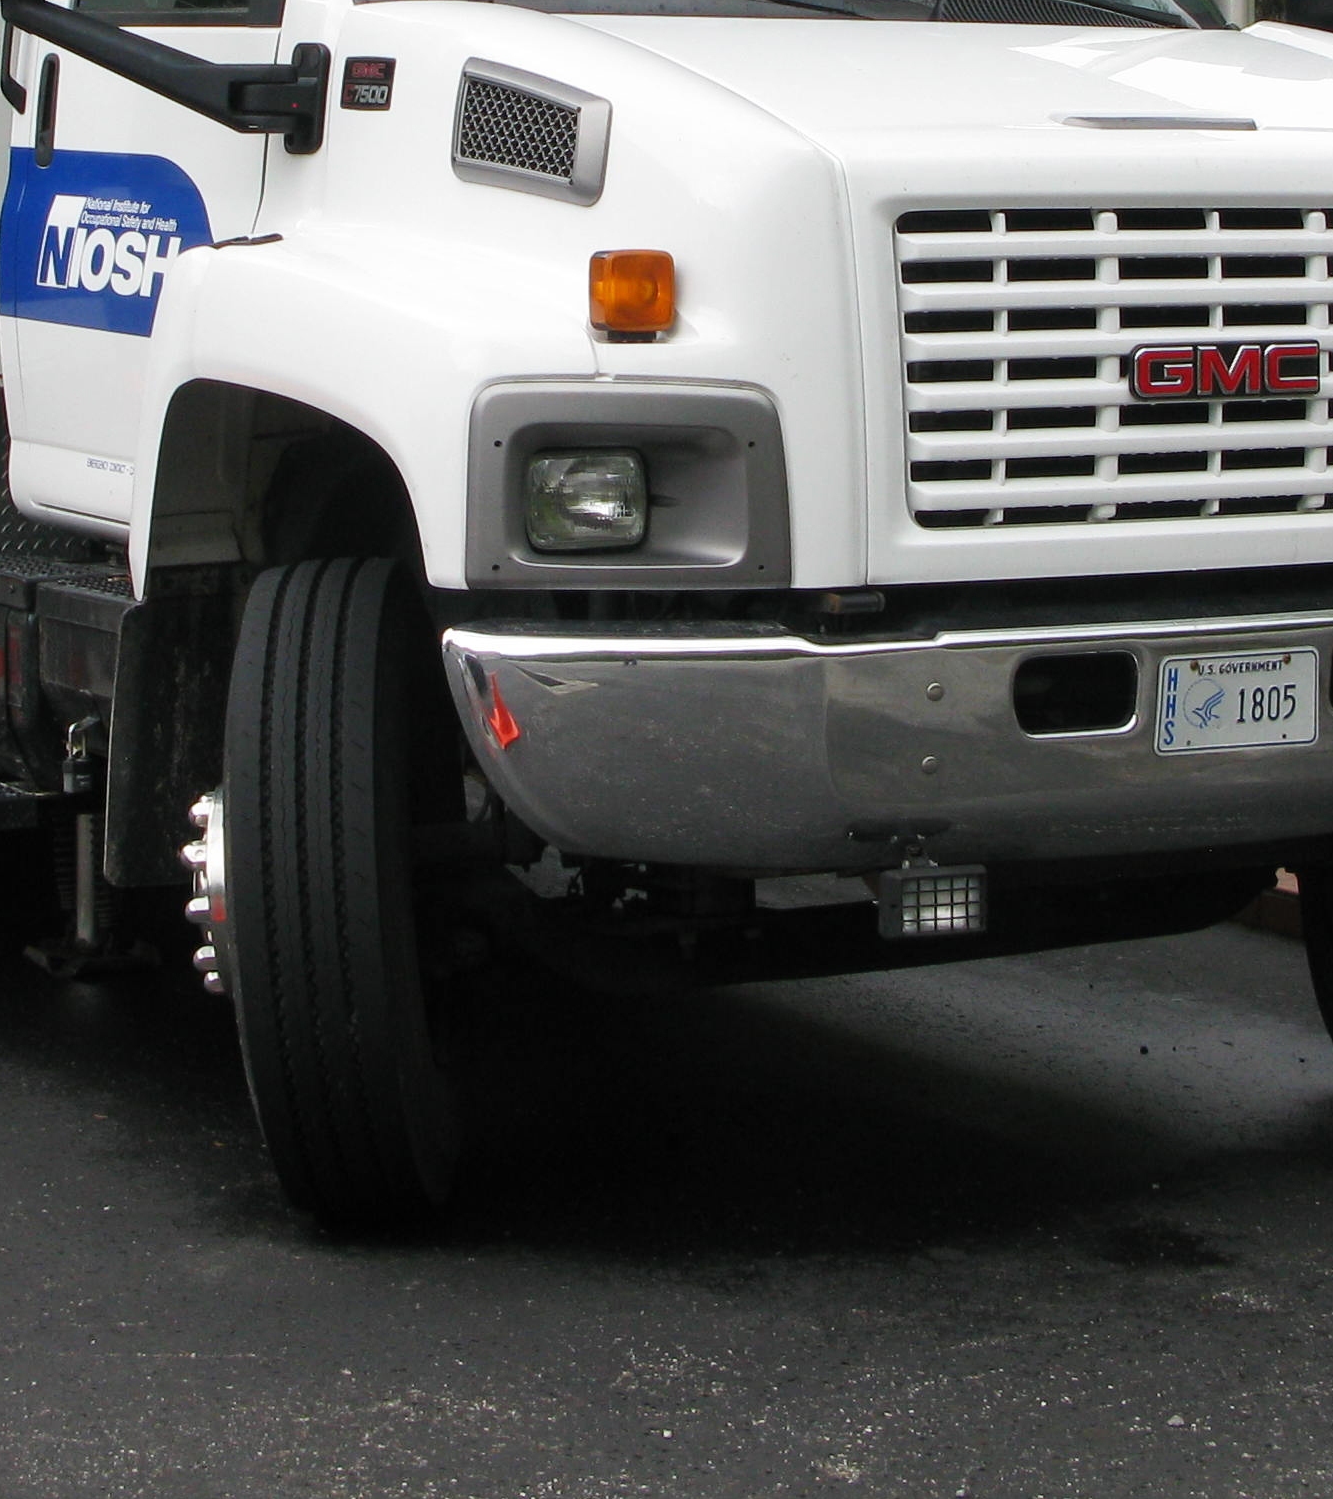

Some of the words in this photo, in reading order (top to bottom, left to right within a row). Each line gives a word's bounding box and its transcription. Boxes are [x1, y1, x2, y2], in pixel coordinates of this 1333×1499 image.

[351, 62, 387, 79] GMC
[343, 83, 389, 104] C7500
[85, 196, 114, 211] National
[113, 199, 140, 214] Institute
[140, 201, 152, 215] for
[81, 210, 121, 228] Occupational
[121, 214, 142, 232] Safety
[141, 217, 155, 230] and
[154, 217, 178, 232] Health
[38, 225, 182, 298] NIOSH
[1134, 343, 1319, 398] GMC
[1197, 665, 1216, 676] U.S.
[1219, 659, 1284, 676] GOVERNMENT
[1163, 667, 1179, 746] HHS
[1236, 684, 1297, 724] 1805
